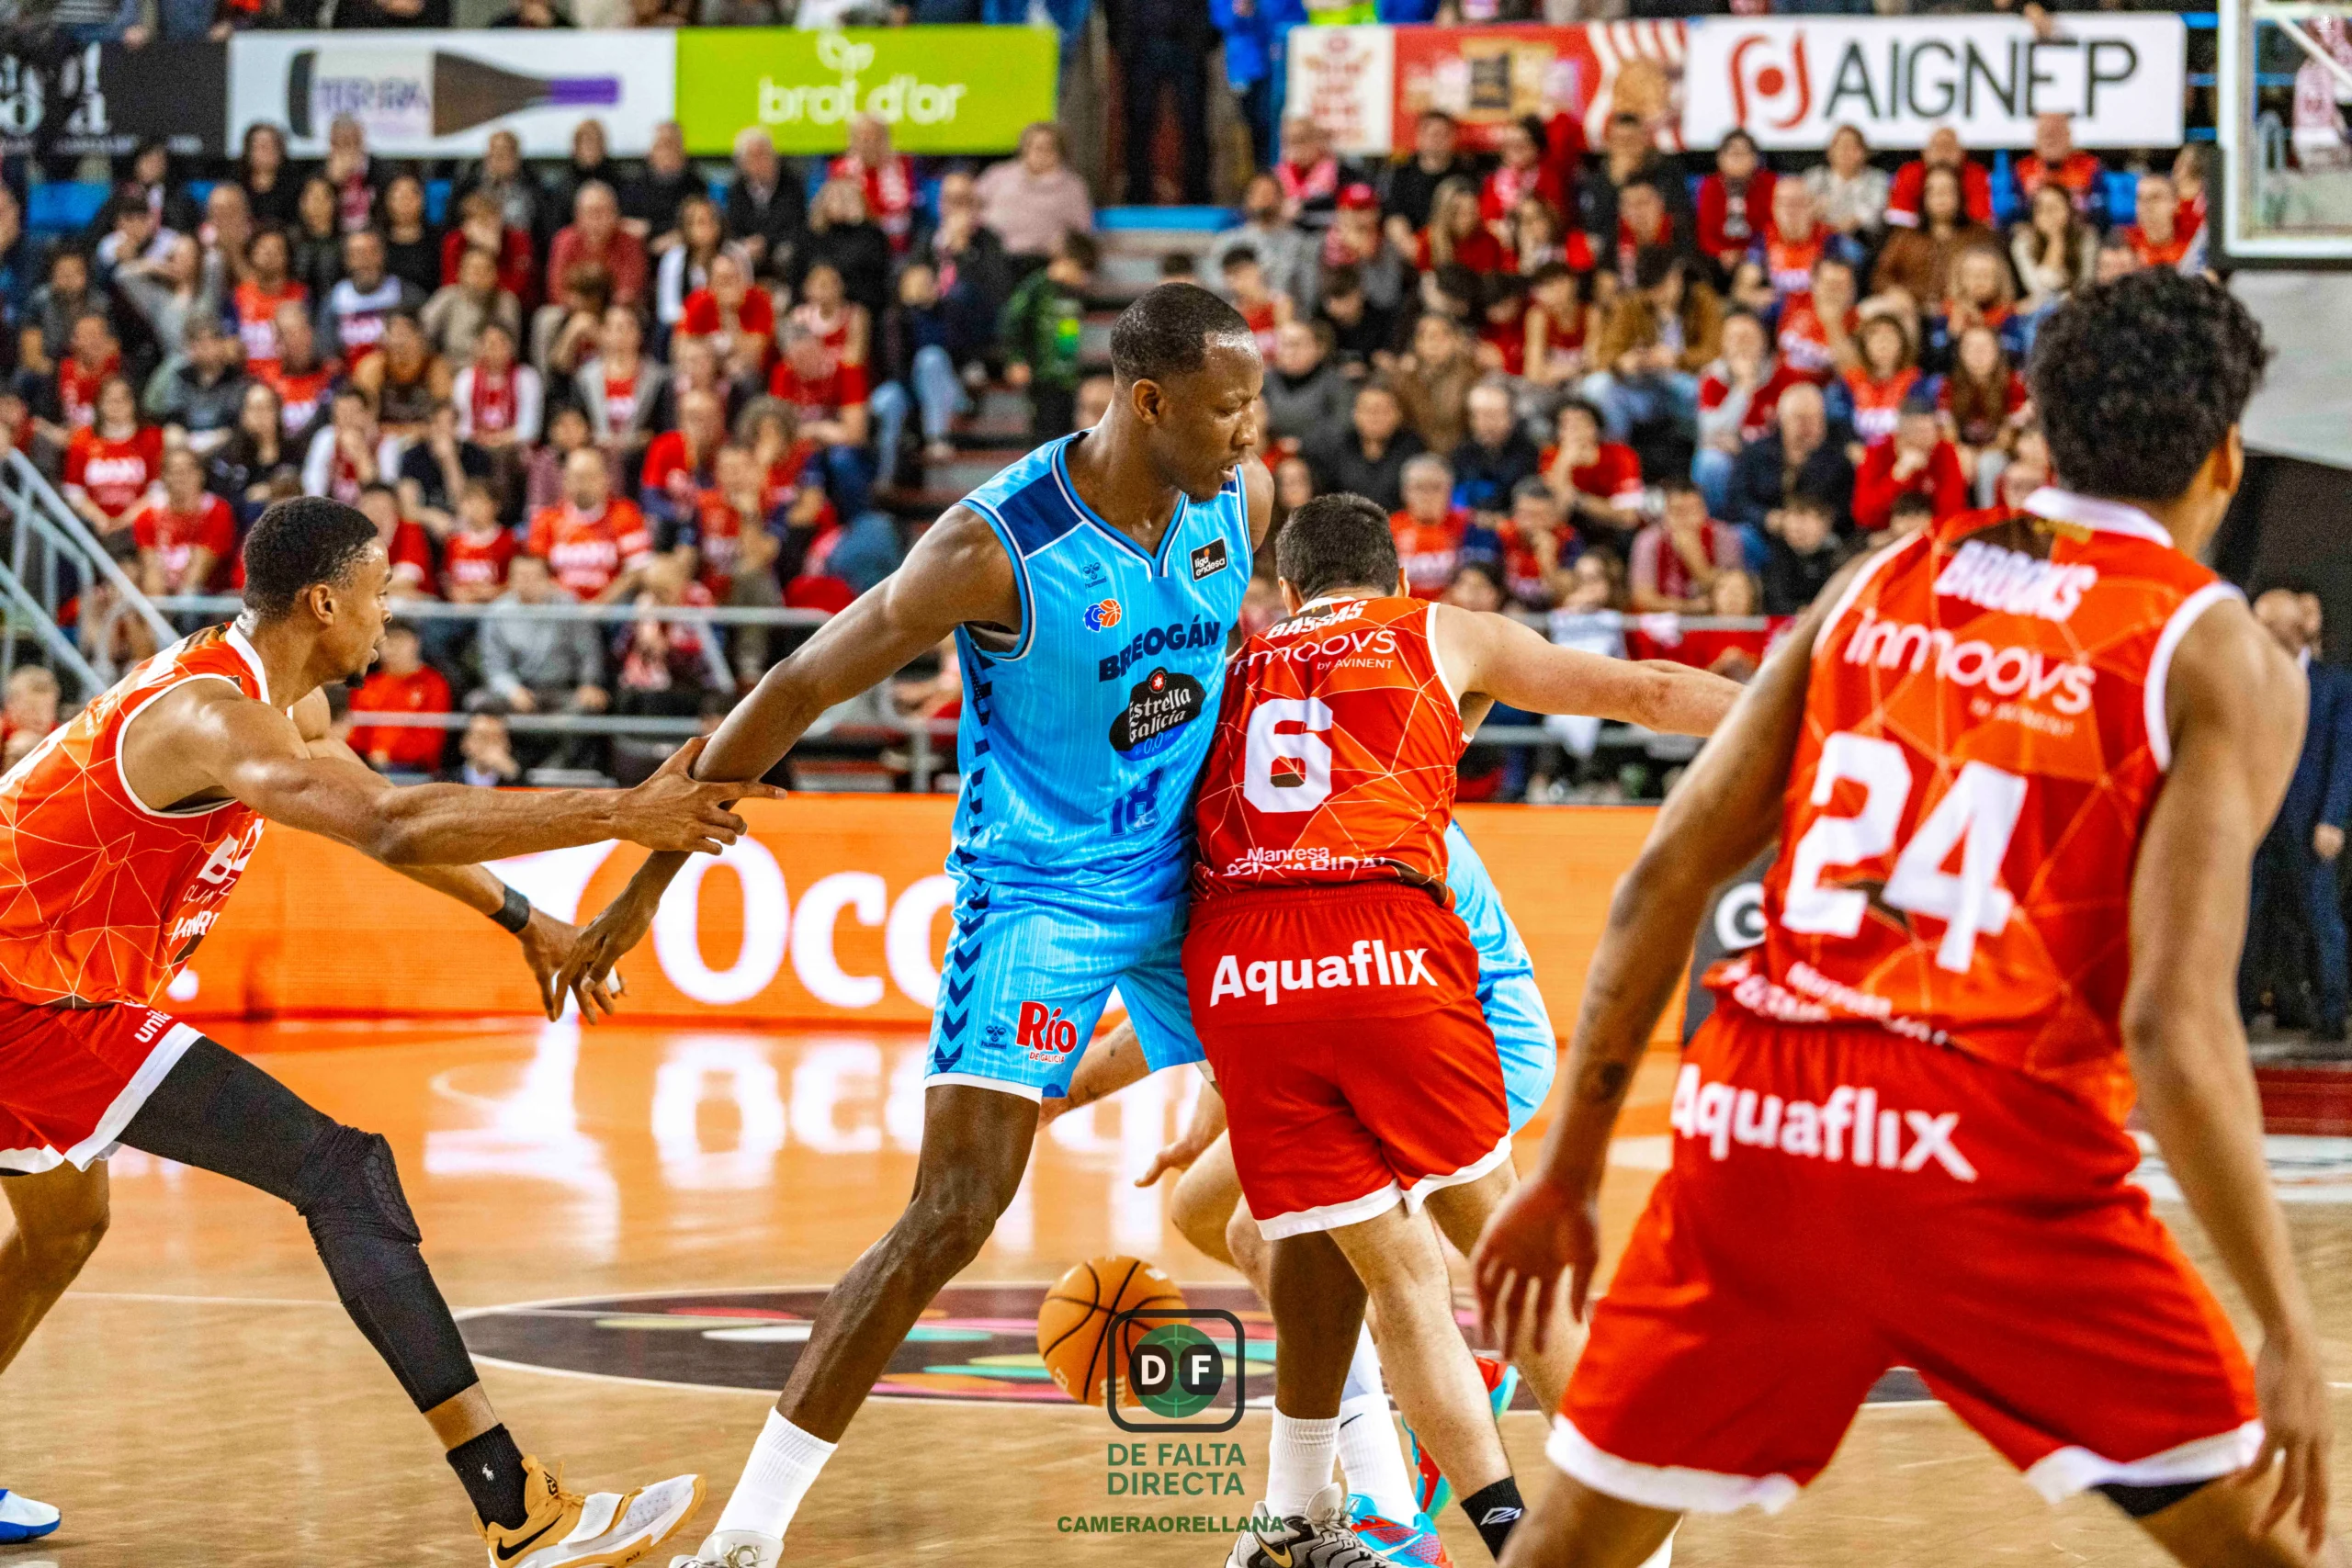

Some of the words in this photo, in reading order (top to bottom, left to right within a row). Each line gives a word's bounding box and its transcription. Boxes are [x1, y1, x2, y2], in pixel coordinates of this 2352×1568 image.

[1823, 39, 2139, 121] AIGNEP
[1194, 556, 1210, 569] liga
[1195, 557, 1226, 577] endesa
[1265, 600, 1369, 640] BASSAS
[1098, 614, 1222, 682] BREOGÁN
[1317, 661, 1332, 671] by
[1334, 658, 1396, 670] AVINENT
[1843, 606, 2098, 715] inmoovs
[1243, 696, 1333, 813] 6
[1110, 766, 1163, 837] 18
[1246, 847, 1330, 863] Manresa
[1781, 730, 2030, 974] 24
[980, 1040, 1008, 1051] hummel
[1014, 1000, 1078, 1055] Río
[1039, 1053, 1066, 1065] GALICIA
